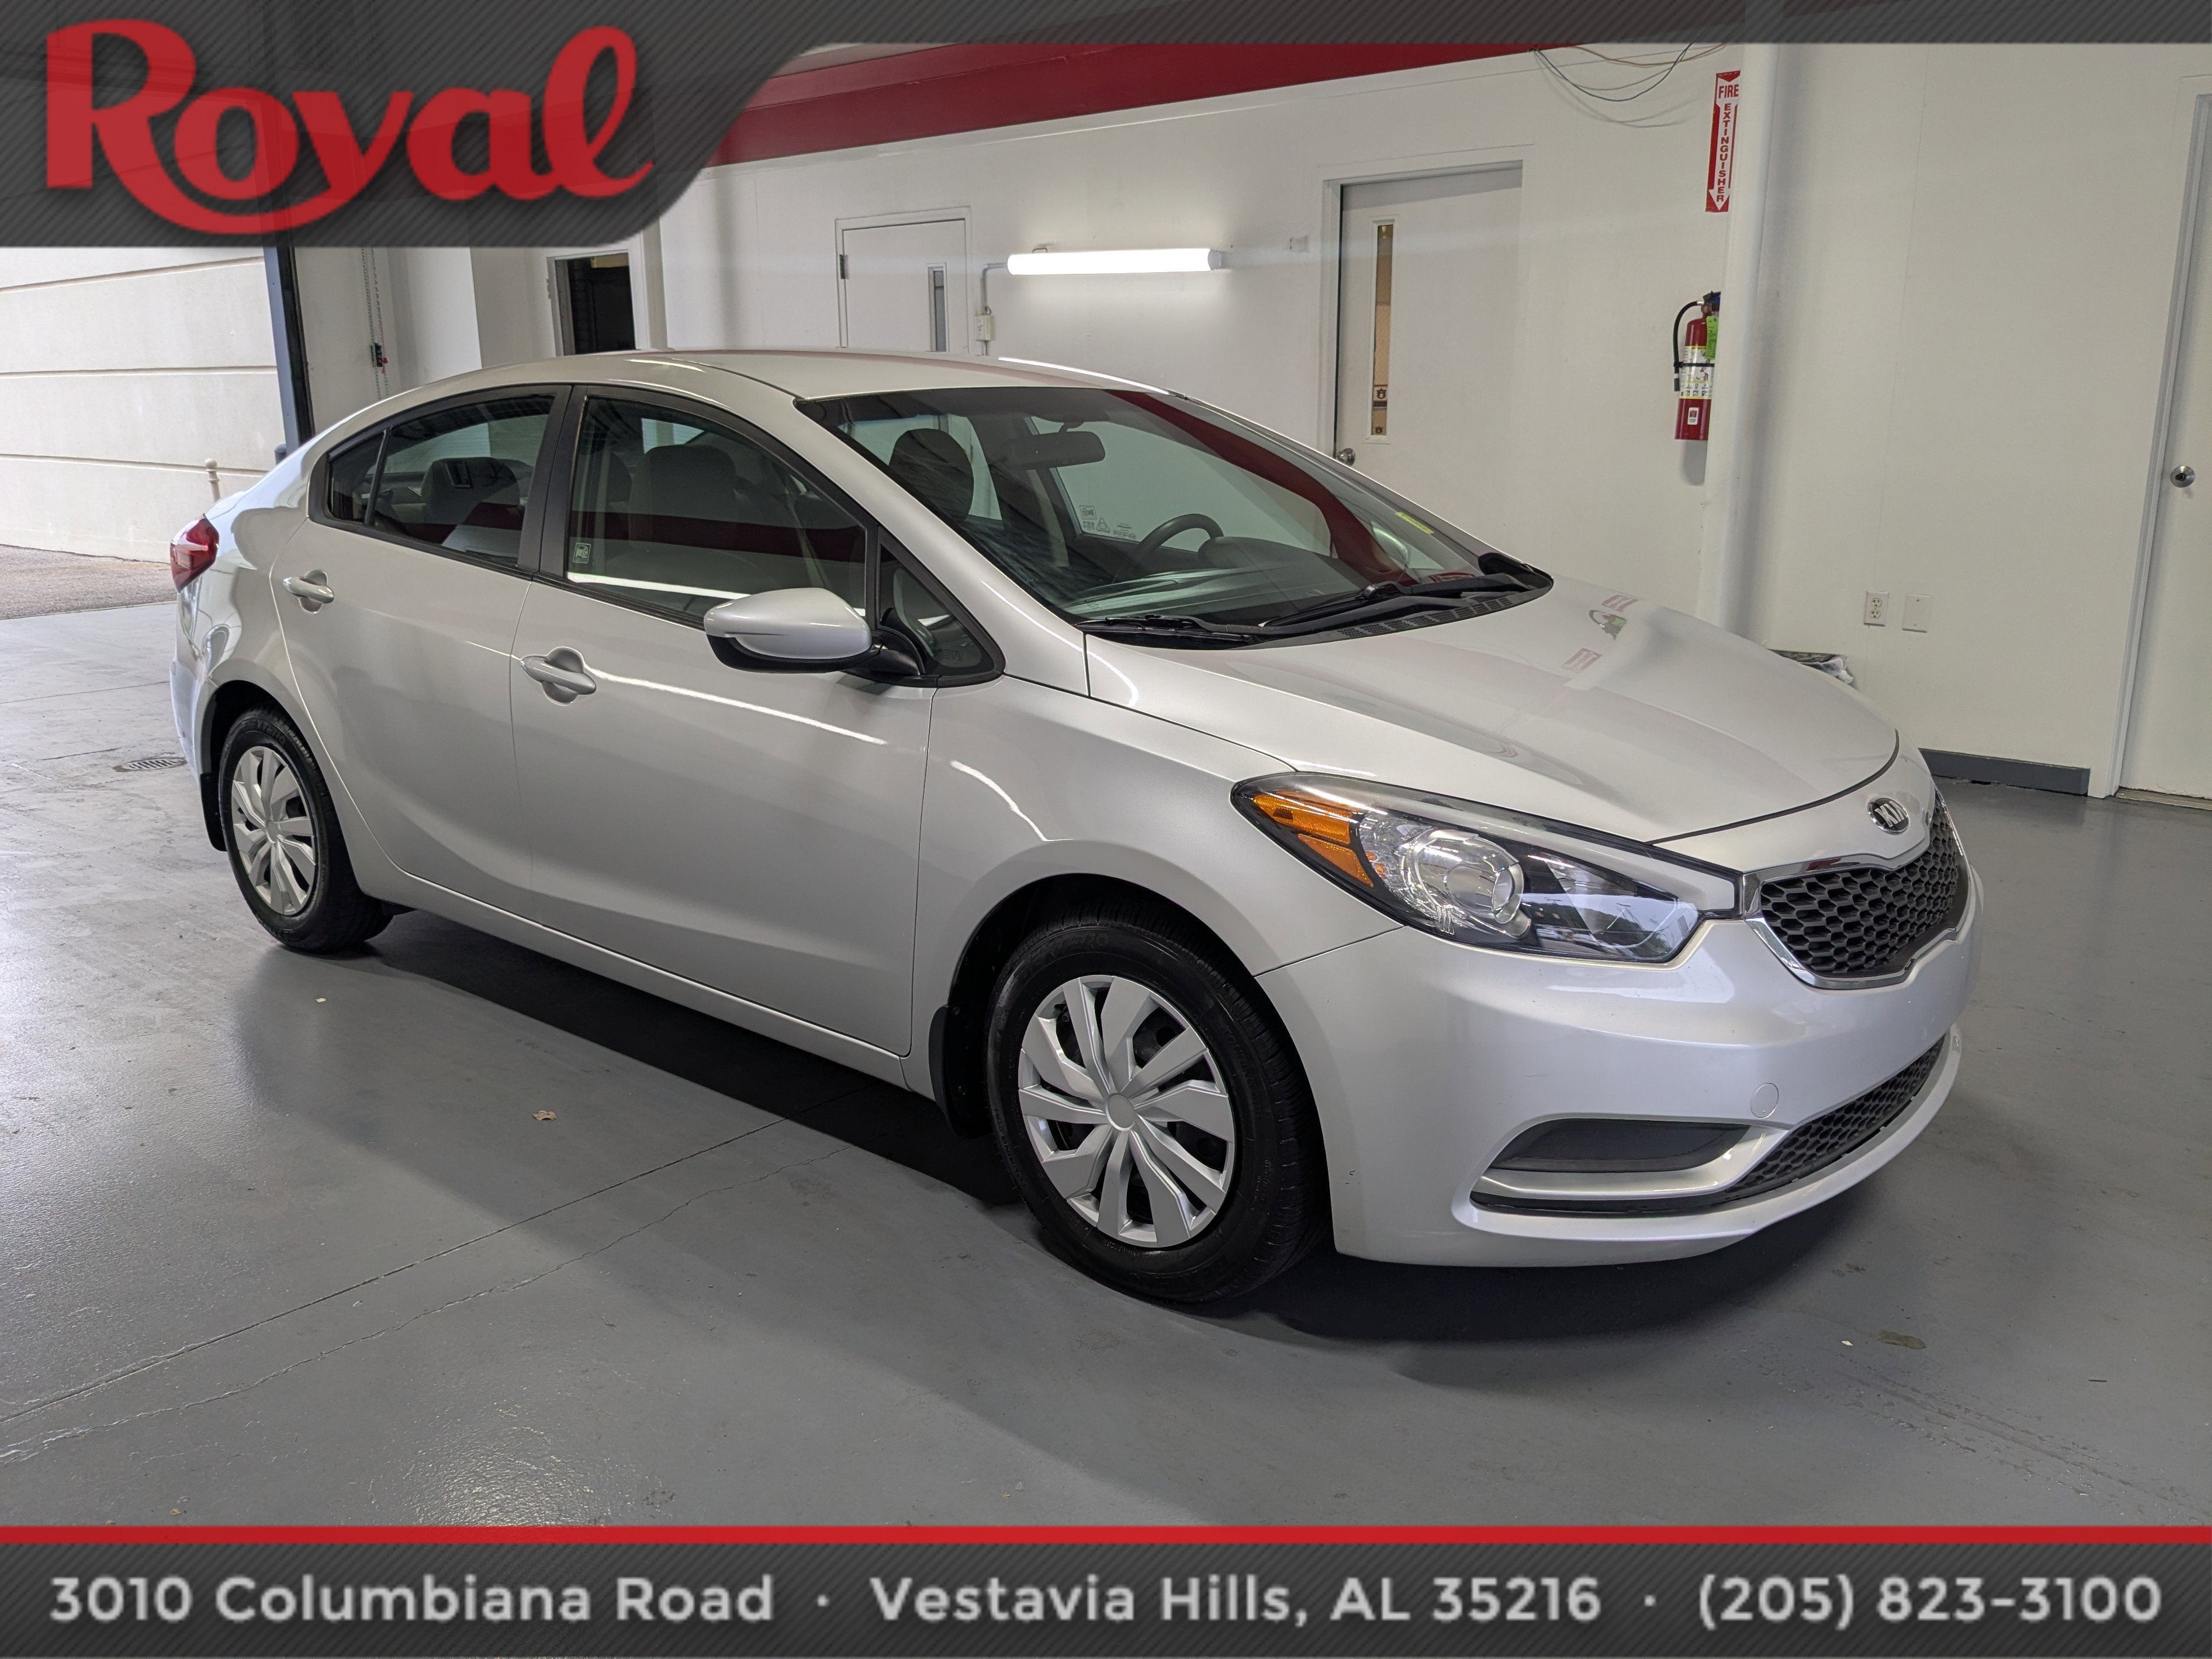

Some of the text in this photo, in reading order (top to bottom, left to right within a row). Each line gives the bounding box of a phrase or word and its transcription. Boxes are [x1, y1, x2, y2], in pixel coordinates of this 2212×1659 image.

[1718, 84, 1739, 99] FIRE
[1716, 103, 1731, 202] EXTINGUISHER
[1875, 800, 1908, 827] KIA
